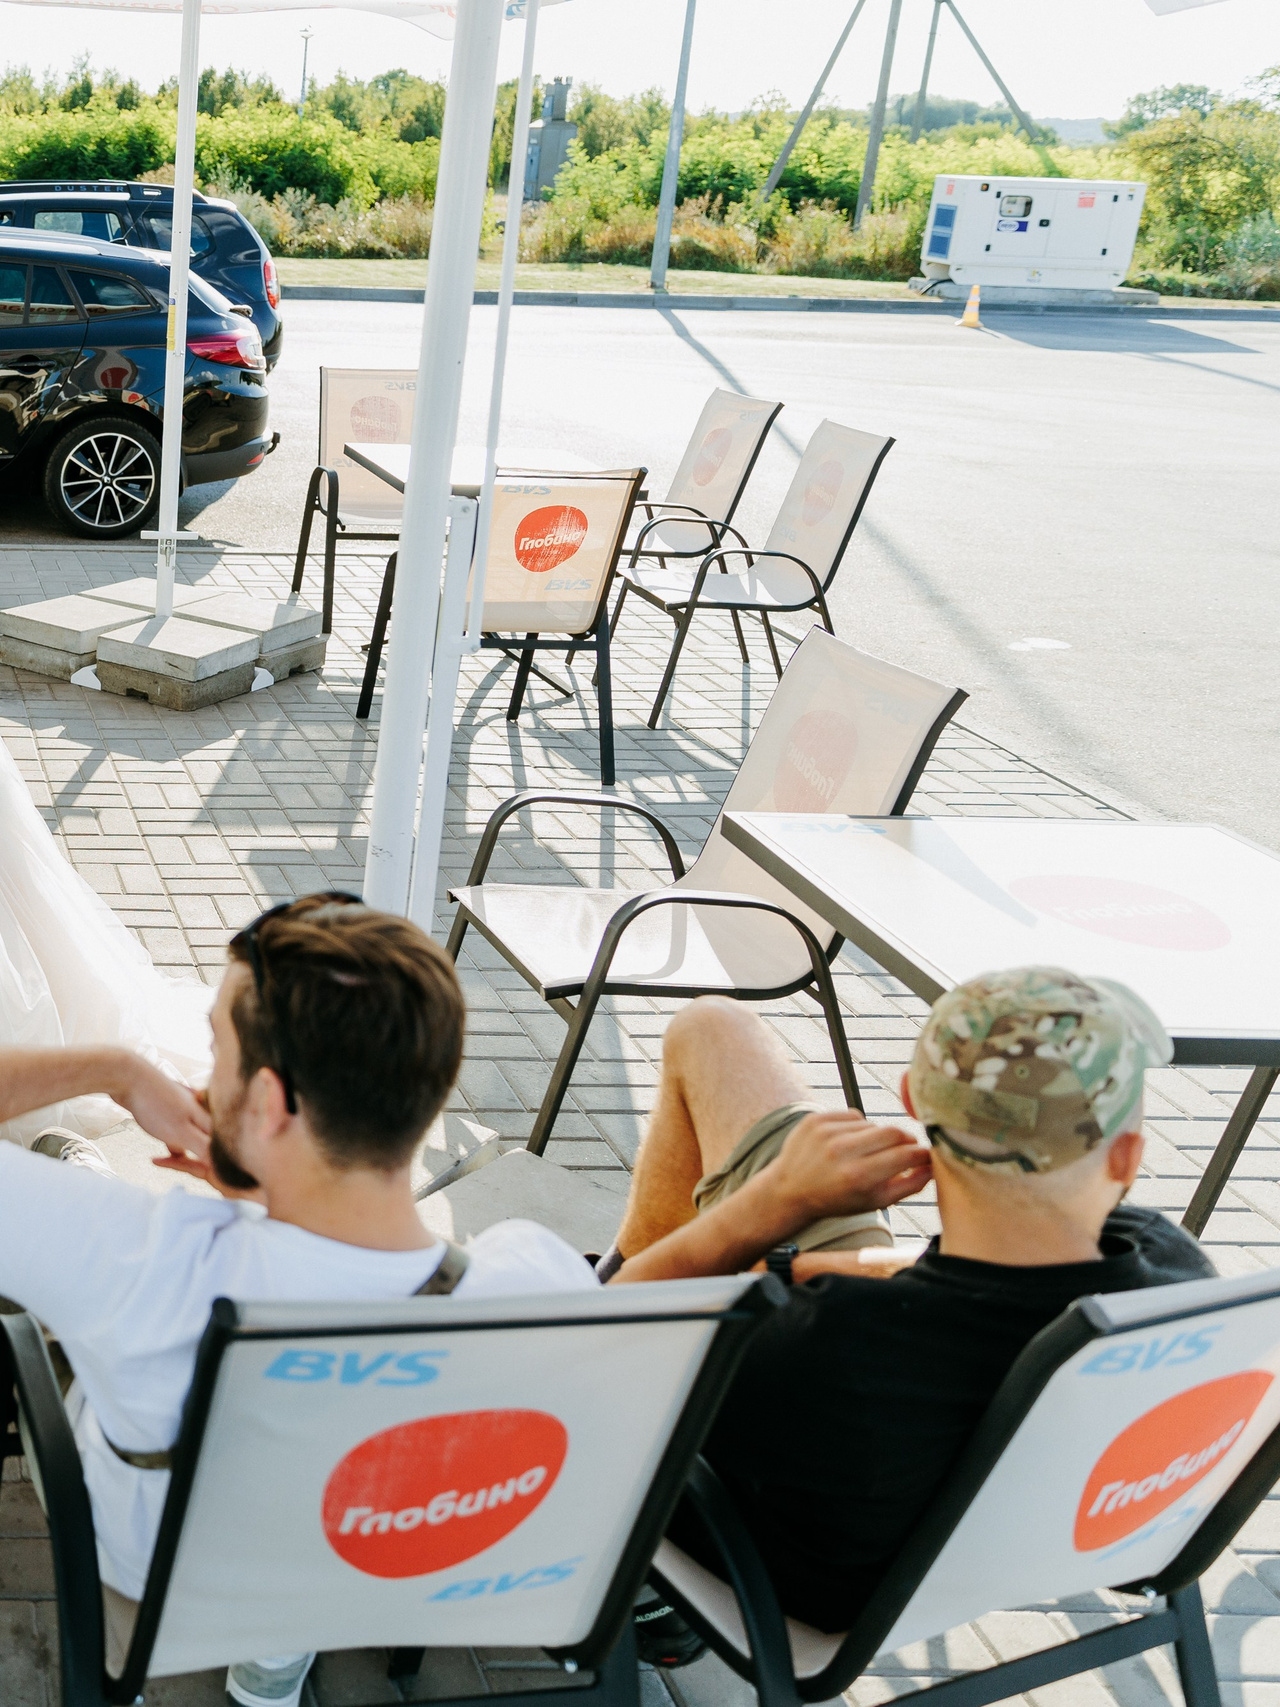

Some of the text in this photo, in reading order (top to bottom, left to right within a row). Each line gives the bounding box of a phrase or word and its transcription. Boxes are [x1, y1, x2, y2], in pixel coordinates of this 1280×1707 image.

[519, 531, 581, 550] Глобино
[544, 578, 593, 590] BVS
[780, 822, 888, 835] BVS
[261, 1348, 451, 1388] BVS
[1077, 1323, 1226, 1377] BVS
[1085, 1418, 1246, 1519] Глобино
[338, 1464, 548, 1537] Глобино
[425, 1555, 586, 1603] BVS
[634, 1605, 675, 1623] ALOMON
